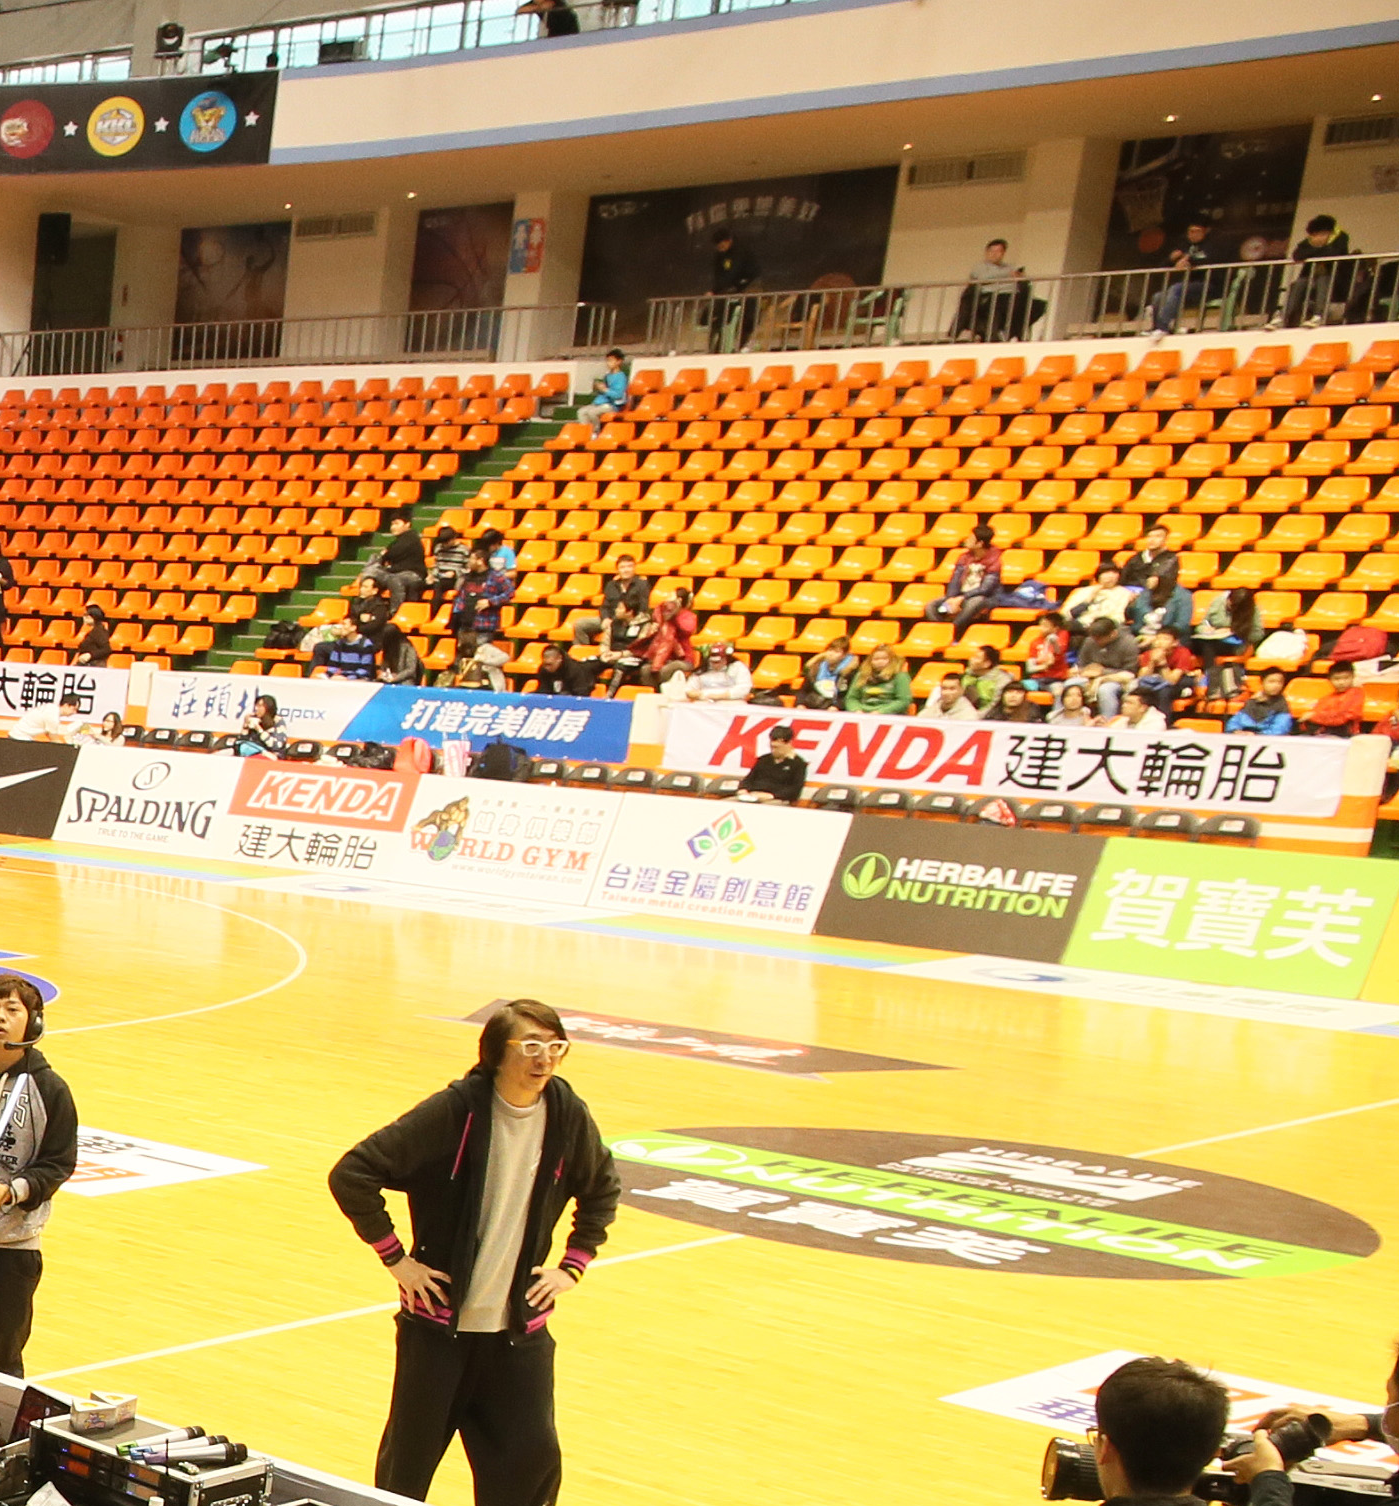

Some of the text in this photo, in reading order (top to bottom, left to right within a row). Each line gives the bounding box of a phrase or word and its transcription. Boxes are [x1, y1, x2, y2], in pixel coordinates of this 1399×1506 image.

[275, 706, 327, 723] opax
[402, 699, 590, 743] 打造完美廚房
[999, 733, 1287, 803] 建大輪胎
[67, 786, 217, 840] SPALDING
[247, 771, 403, 821] KENDA
[234, 823, 378, 870] 建大輪胎
[522, 845, 591, 871] GYM
[605, 863, 814, 911] 台灣金屬創意館
[886, 880, 1069, 919] NUTRITION
[895, 857, 1078, 896] HERBALIFE
[602, 891, 804, 925] Taiwan metal creation museum
[1090, 868, 1375, 968] 賀寶芙
[721, 1165, 1272, 1271] NUTRITION
[757, 1159, 1294, 1261] HERBALIFE
